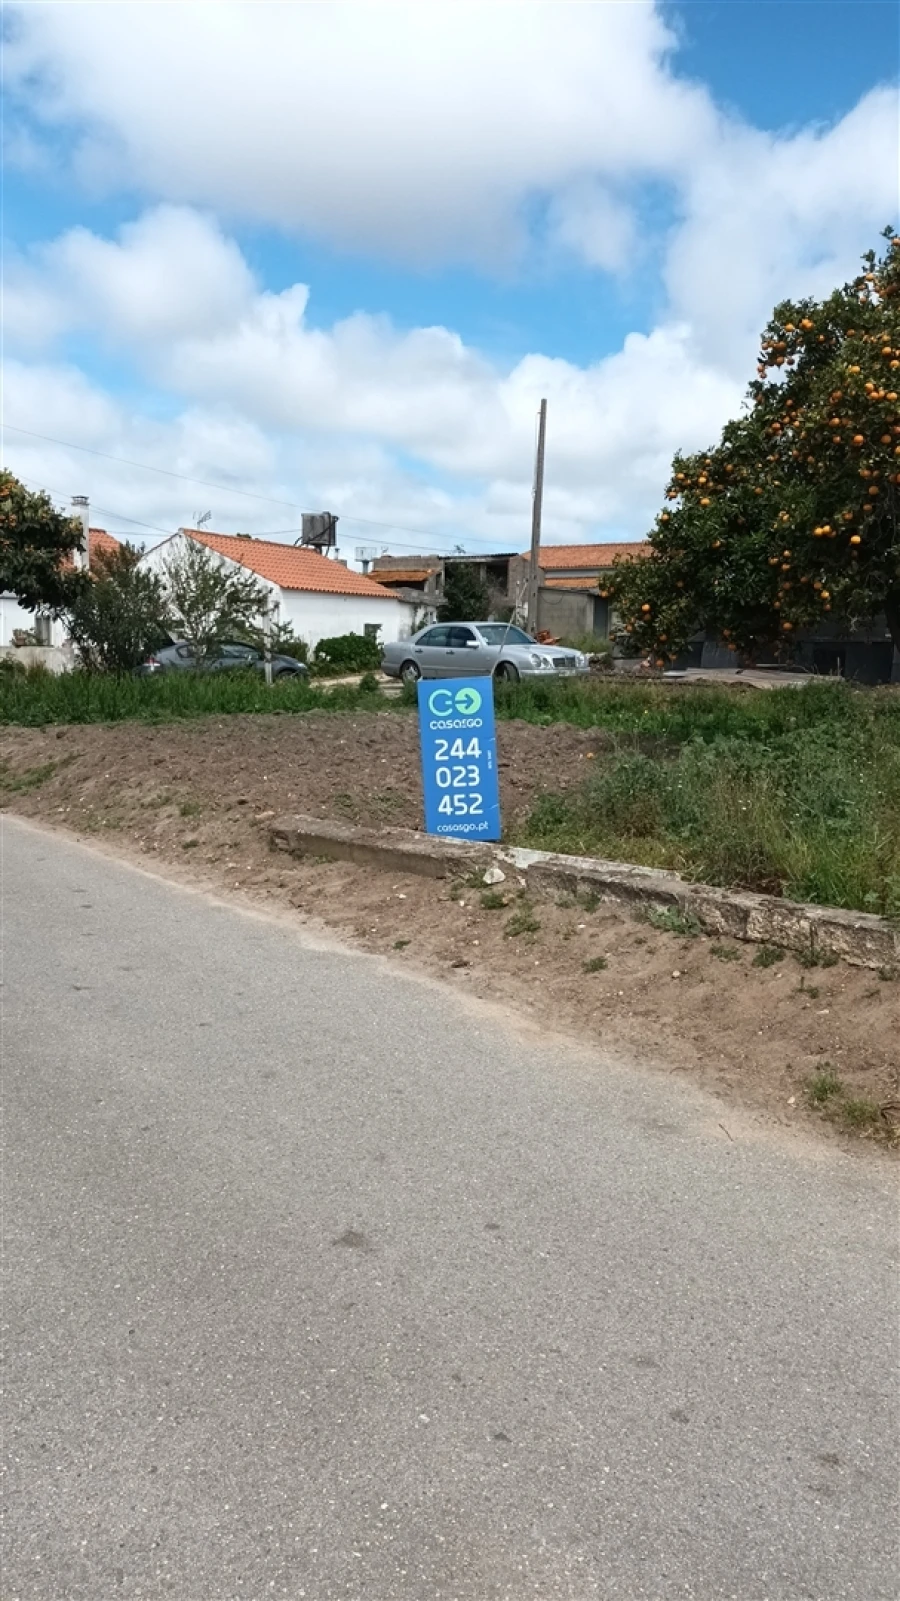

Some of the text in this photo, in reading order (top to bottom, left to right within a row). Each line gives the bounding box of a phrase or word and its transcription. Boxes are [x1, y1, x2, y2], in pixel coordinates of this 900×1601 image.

[434, 737, 482, 761] 244
[435, 765, 480, 788] 023
[438, 793, 484, 816] 452
[436, 821, 489, 832] casasgo.pt
